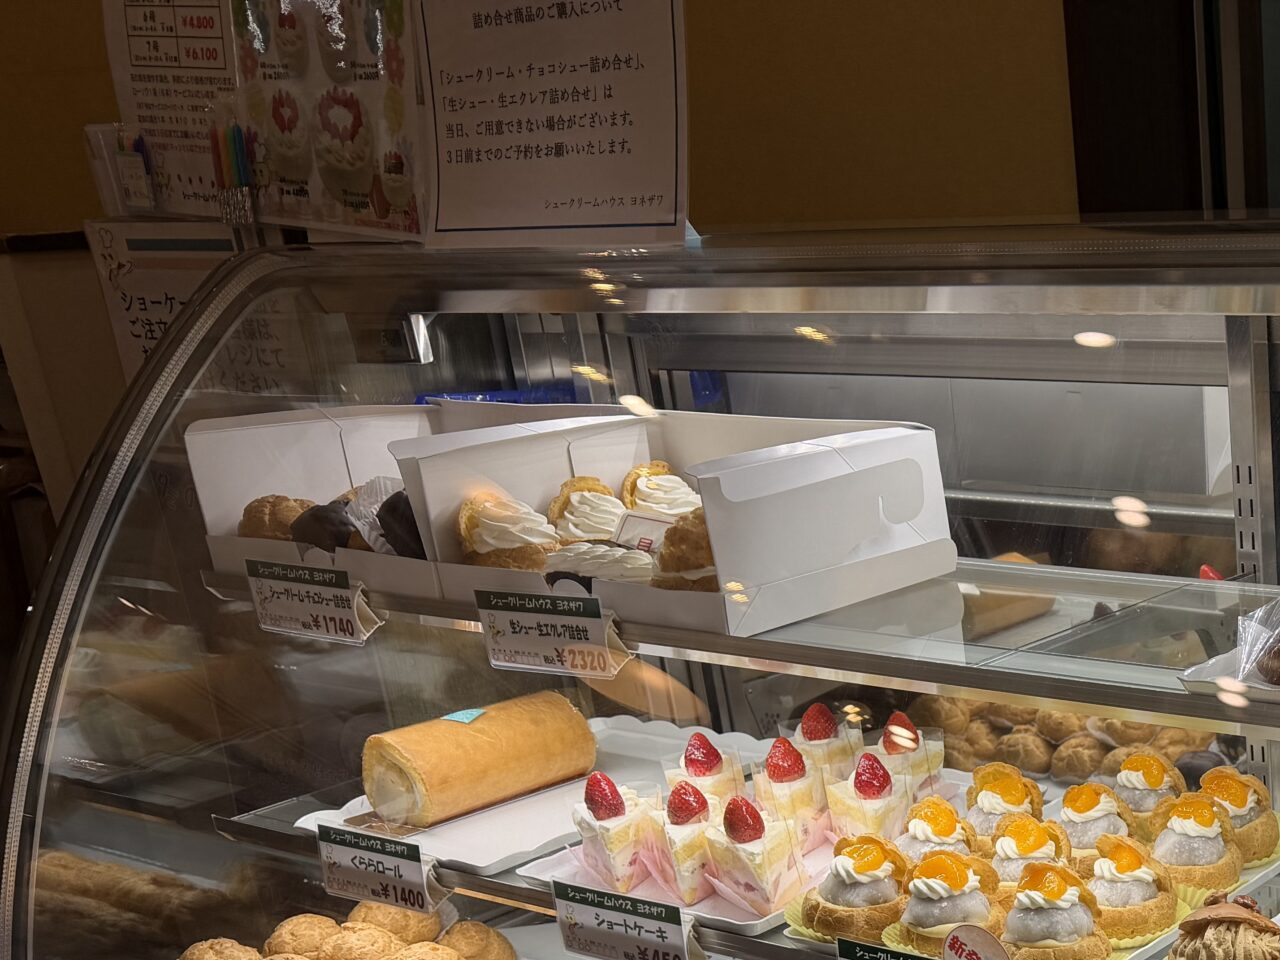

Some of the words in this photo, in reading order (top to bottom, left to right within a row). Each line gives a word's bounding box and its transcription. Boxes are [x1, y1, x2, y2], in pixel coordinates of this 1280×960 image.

[445, 110, 634, 139] 当日、ご用意できない場合がございます。
[544, 196, 626, 210] シュークリームハウス
[630, 194, 664, 208] ヨネザワ
[258, 564, 310, 580] シュークリームハウス
[490, 595, 552, 610] シュークリームハウス
[310, 613, 354, 638] ¥1740
[554, 648, 607, 672] ¥2320
[330, 830, 382, 850] シュークリームハウス
[350, 855, 404, 879] くららロール
[380, 882, 424, 910] ¥1400
[568, 888, 632, 910] シュークリームハウス
[594, 912, 668, 943] ショートケーキ
